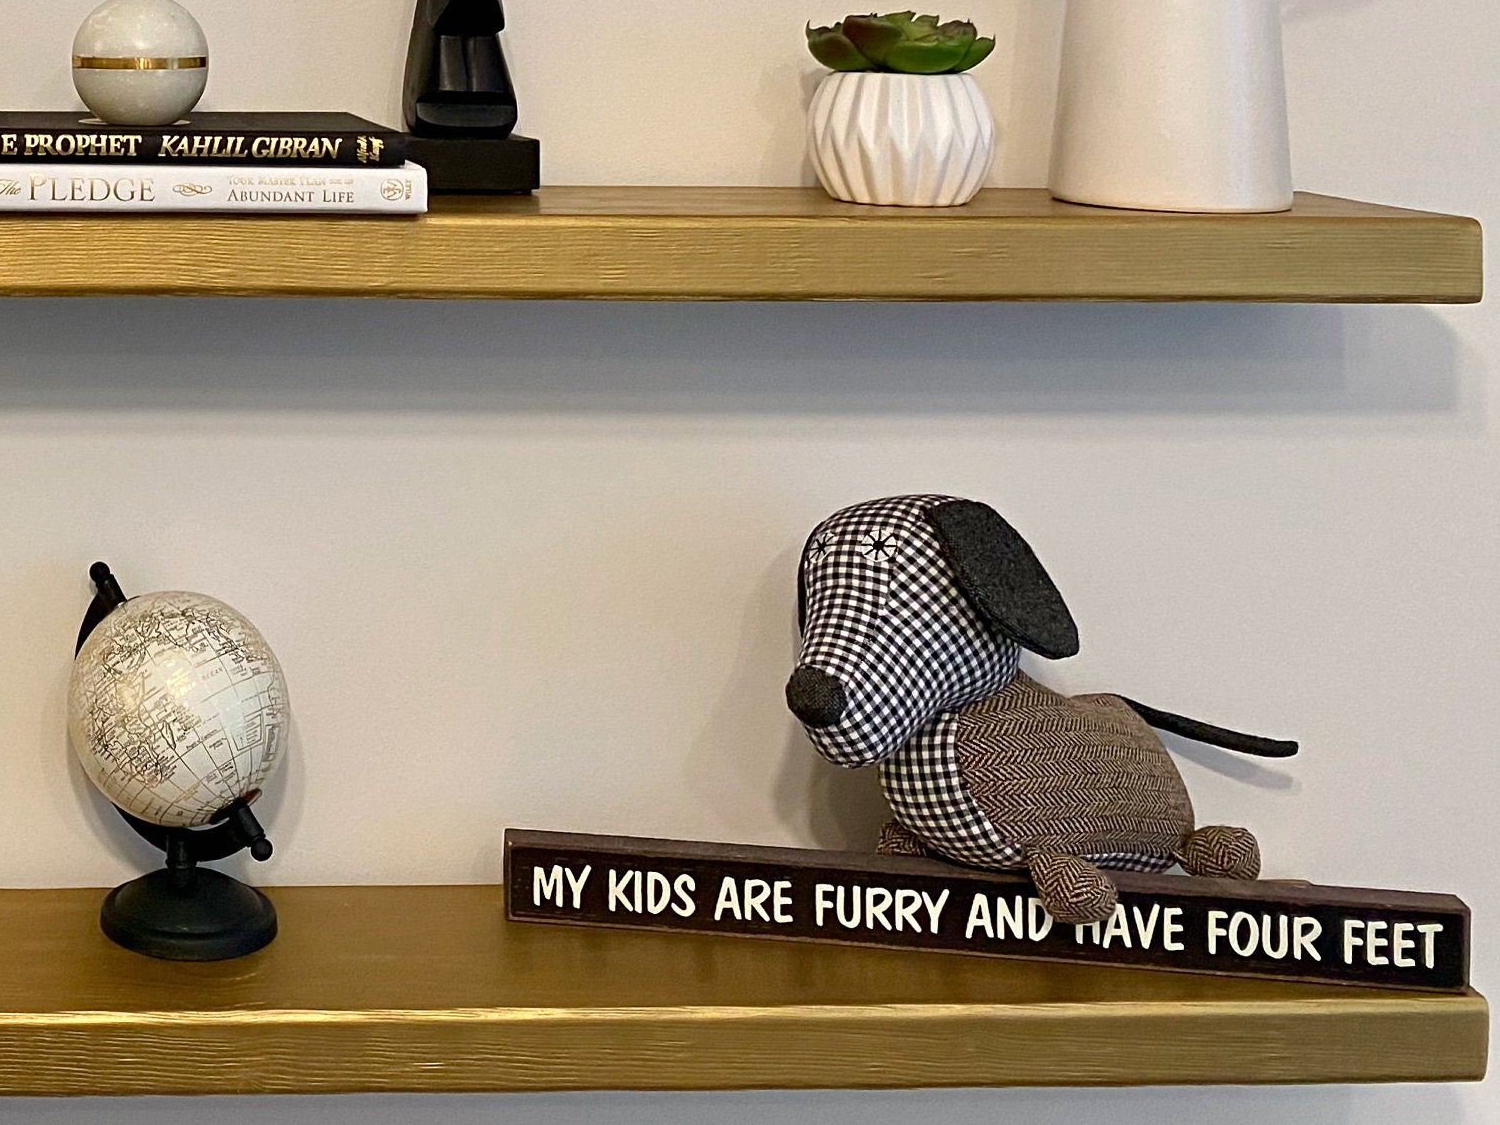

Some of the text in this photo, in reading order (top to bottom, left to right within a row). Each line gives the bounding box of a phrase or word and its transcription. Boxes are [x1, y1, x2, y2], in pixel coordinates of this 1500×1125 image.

[23, 133, 143, 157] PROPHET
[157, 135, 249, 158] KAHLIL
[251, 136, 343, 159] GIBRAN
[28, 172, 156, 202] PLEDGE
[227, 188, 355, 203] ABUNDANT LIFE
[533, 864, 592, 909] MY
[608, 868, 696, 918] KIDS
[714, 876, 794, 923] ARE
[815, 883, 950, 935] FURRY
[965, 892, 1054, 942] AND
[1207, 910, 1323, 962] FOUR
[1343, 919, 1443, 969] FEET
